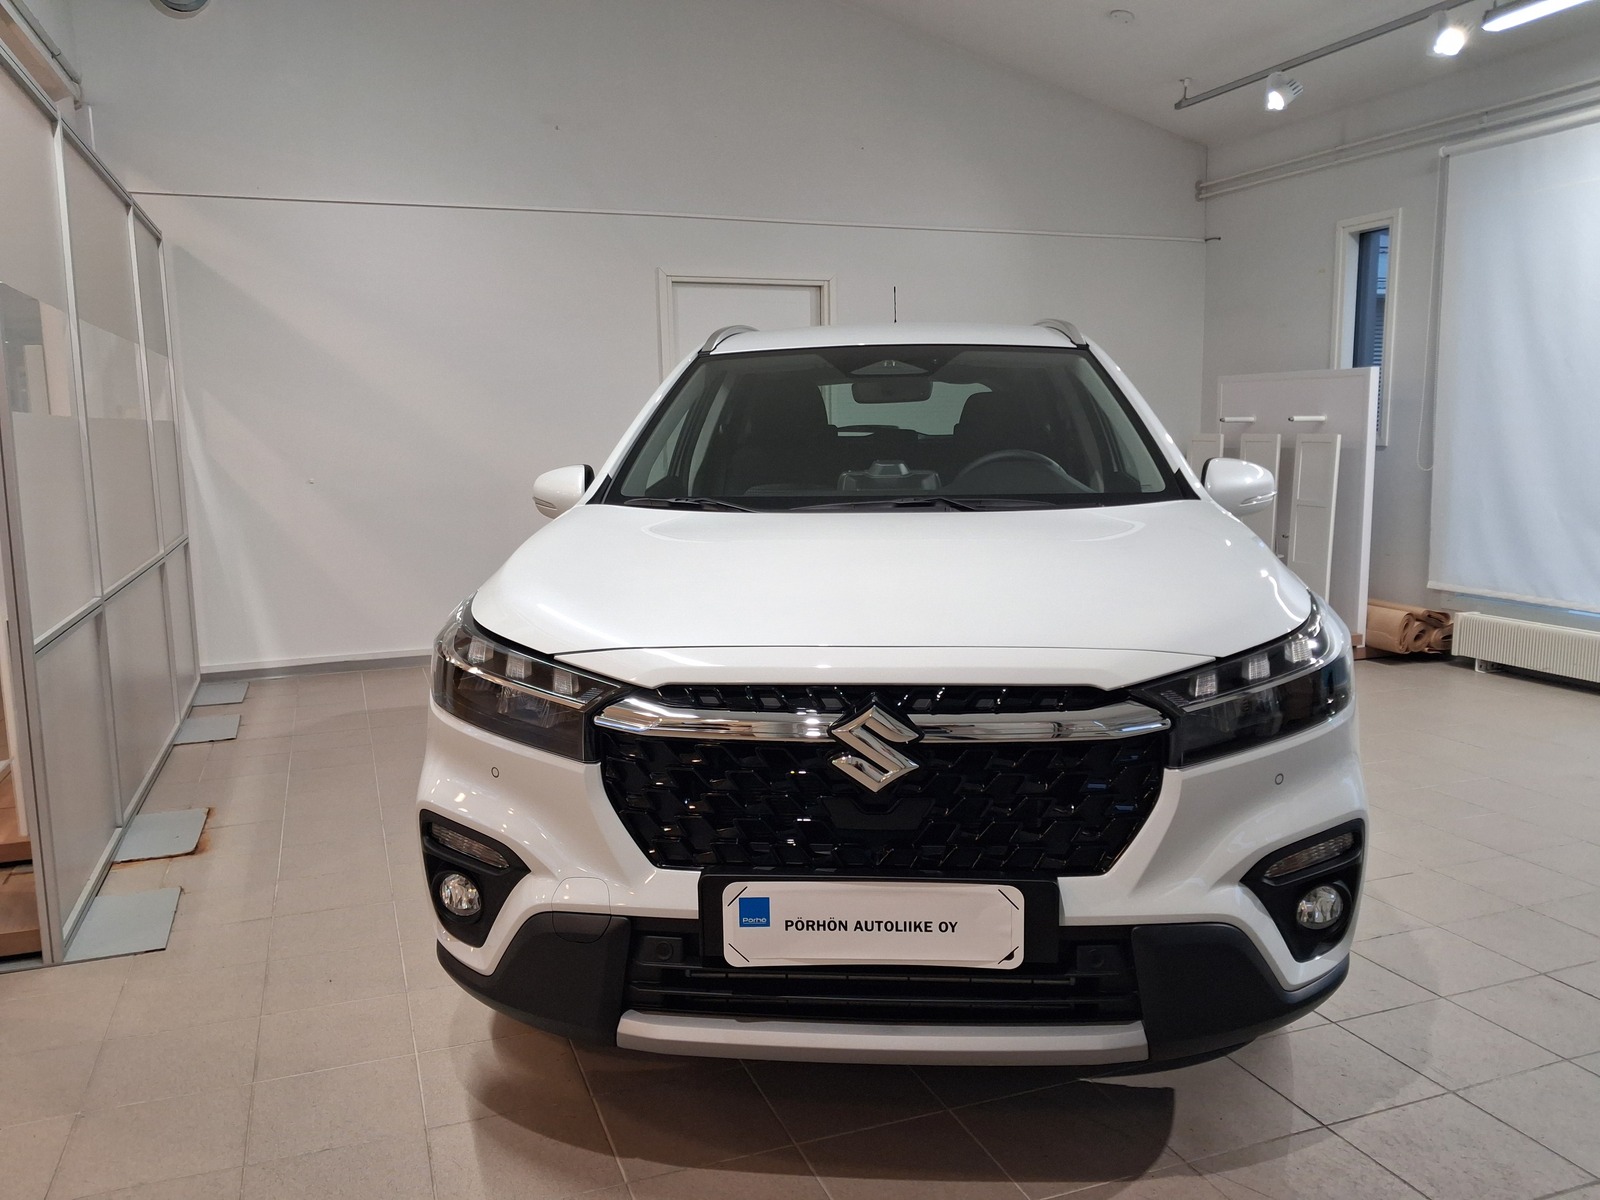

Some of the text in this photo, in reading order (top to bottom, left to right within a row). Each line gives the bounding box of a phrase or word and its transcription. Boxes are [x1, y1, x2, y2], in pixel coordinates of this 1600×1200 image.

[785, 917, 958, 933] PÖRHÖN AUTOLIIKE OY
